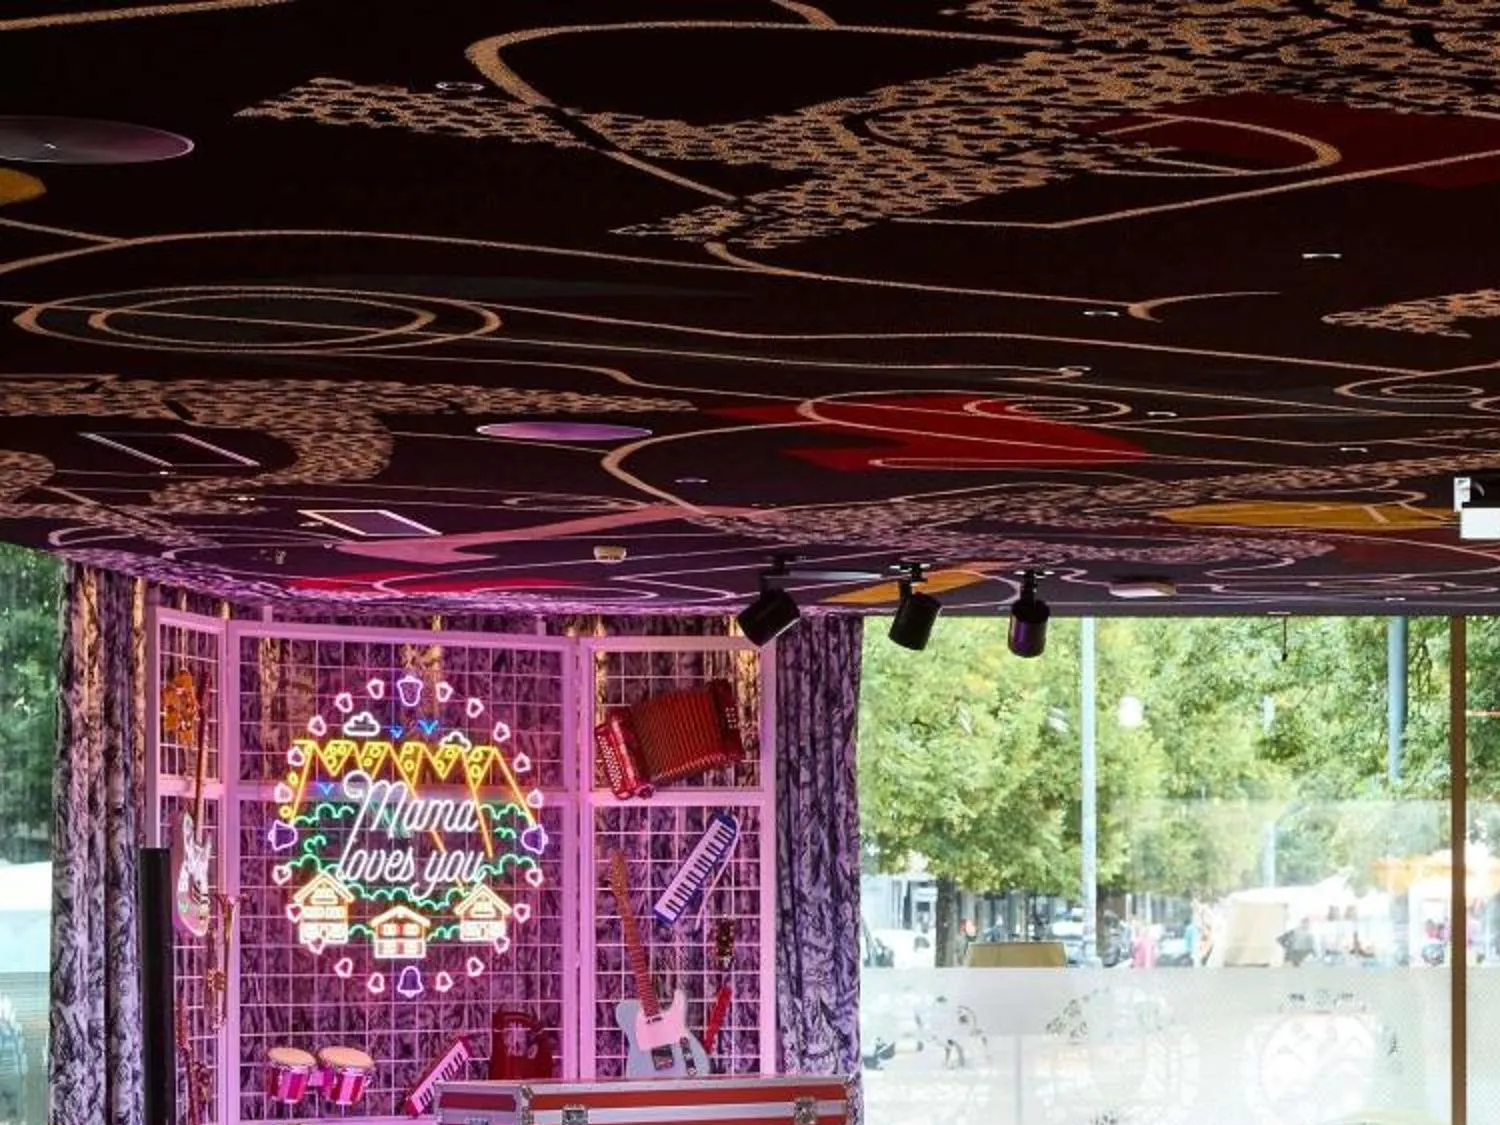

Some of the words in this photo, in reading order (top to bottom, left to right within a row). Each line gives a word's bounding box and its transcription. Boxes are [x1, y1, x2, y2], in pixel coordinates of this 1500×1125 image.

[343, 769, 480, 839] Mama
[335, 836, 416, 884] loves
[410, 849, 487, 900] you
